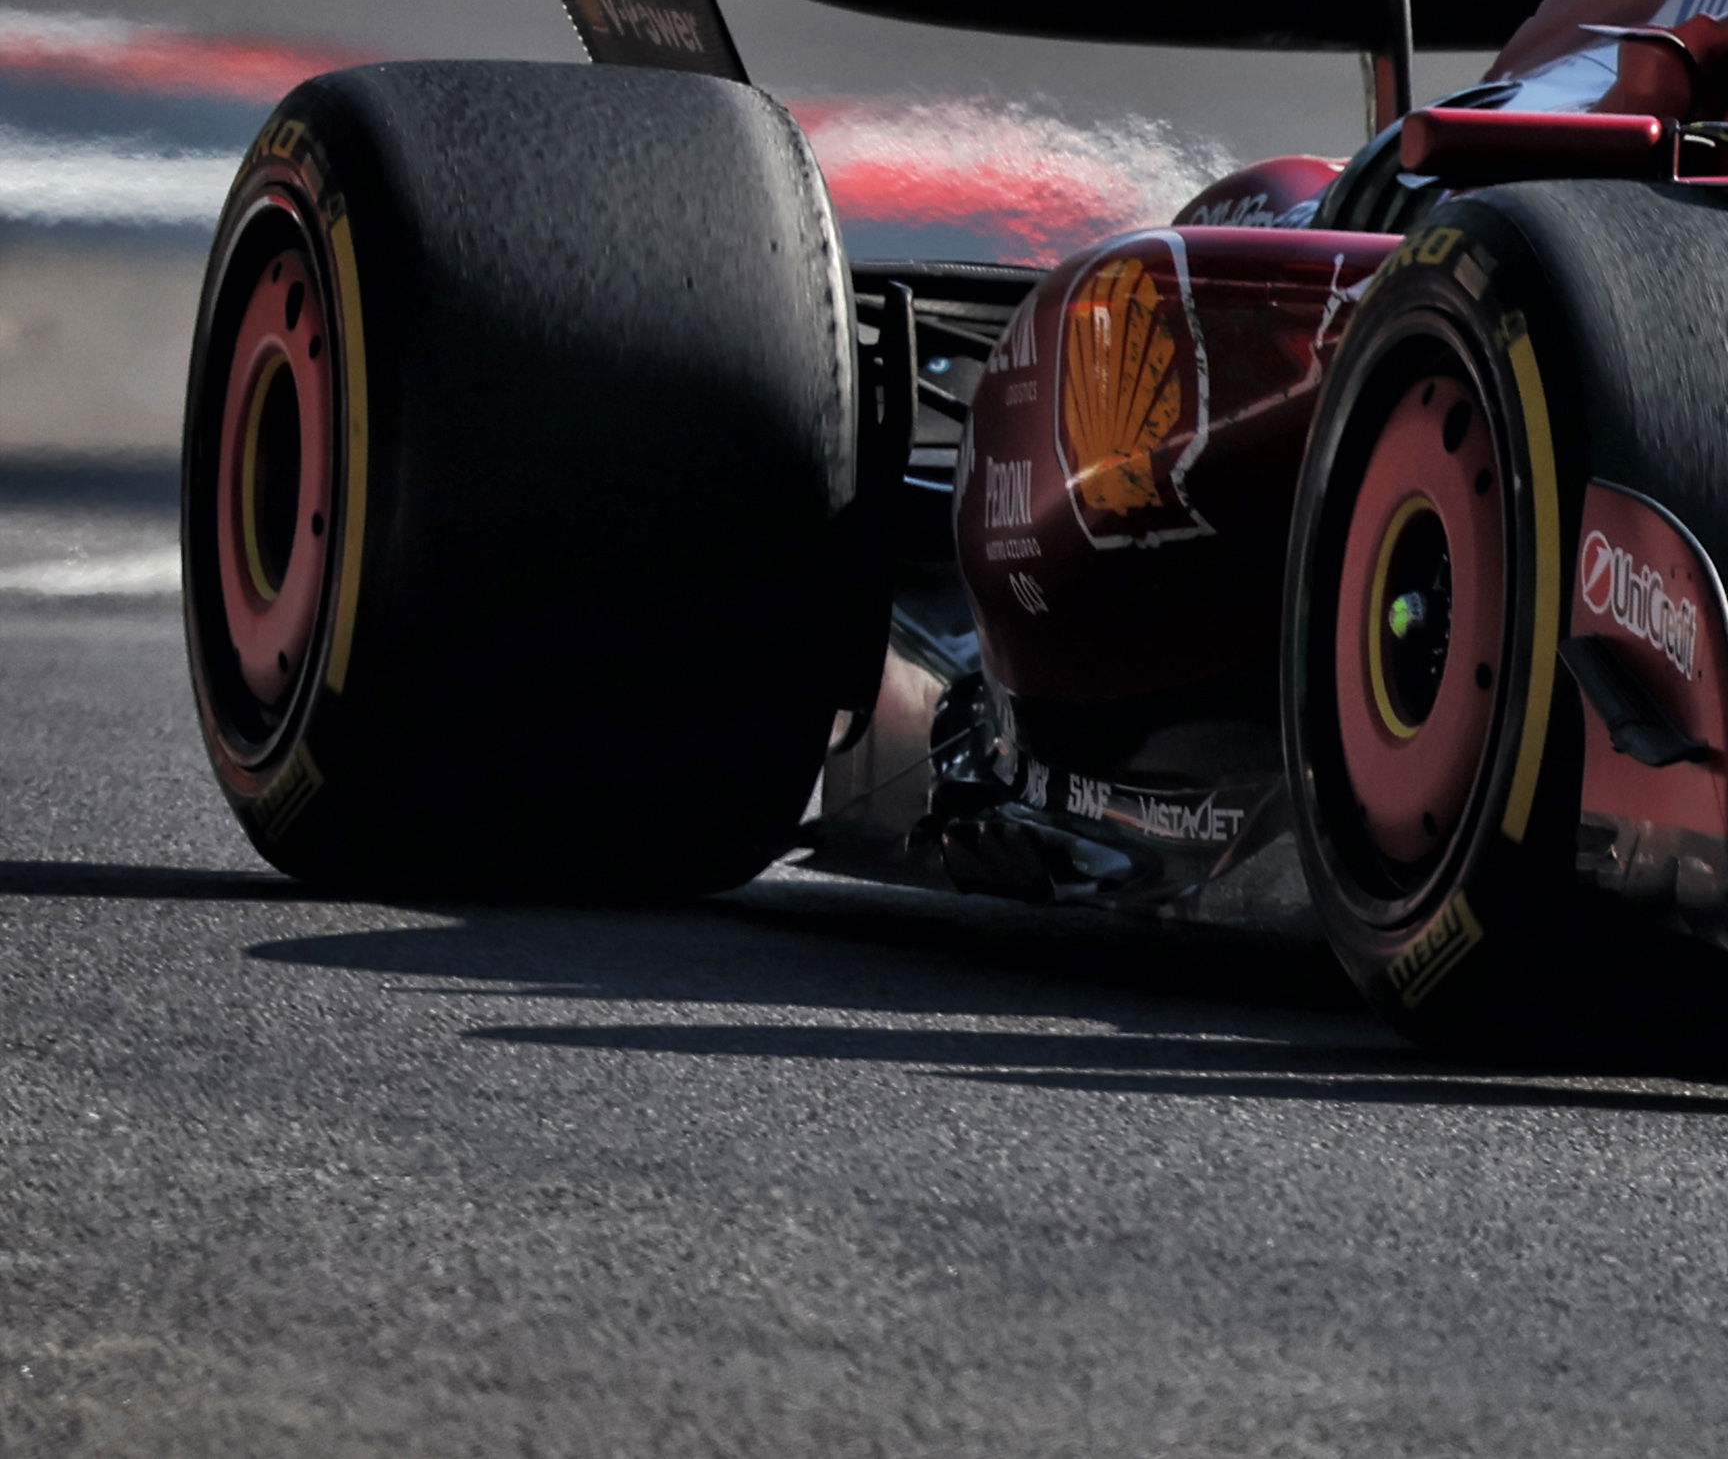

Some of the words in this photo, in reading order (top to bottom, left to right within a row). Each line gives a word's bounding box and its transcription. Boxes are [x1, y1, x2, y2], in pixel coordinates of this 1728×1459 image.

[985, 455, 1033, 528] PERONI
[1611, 546, 1698, 682] UniCredit
[1066, 773, 1113, 821] SKF
